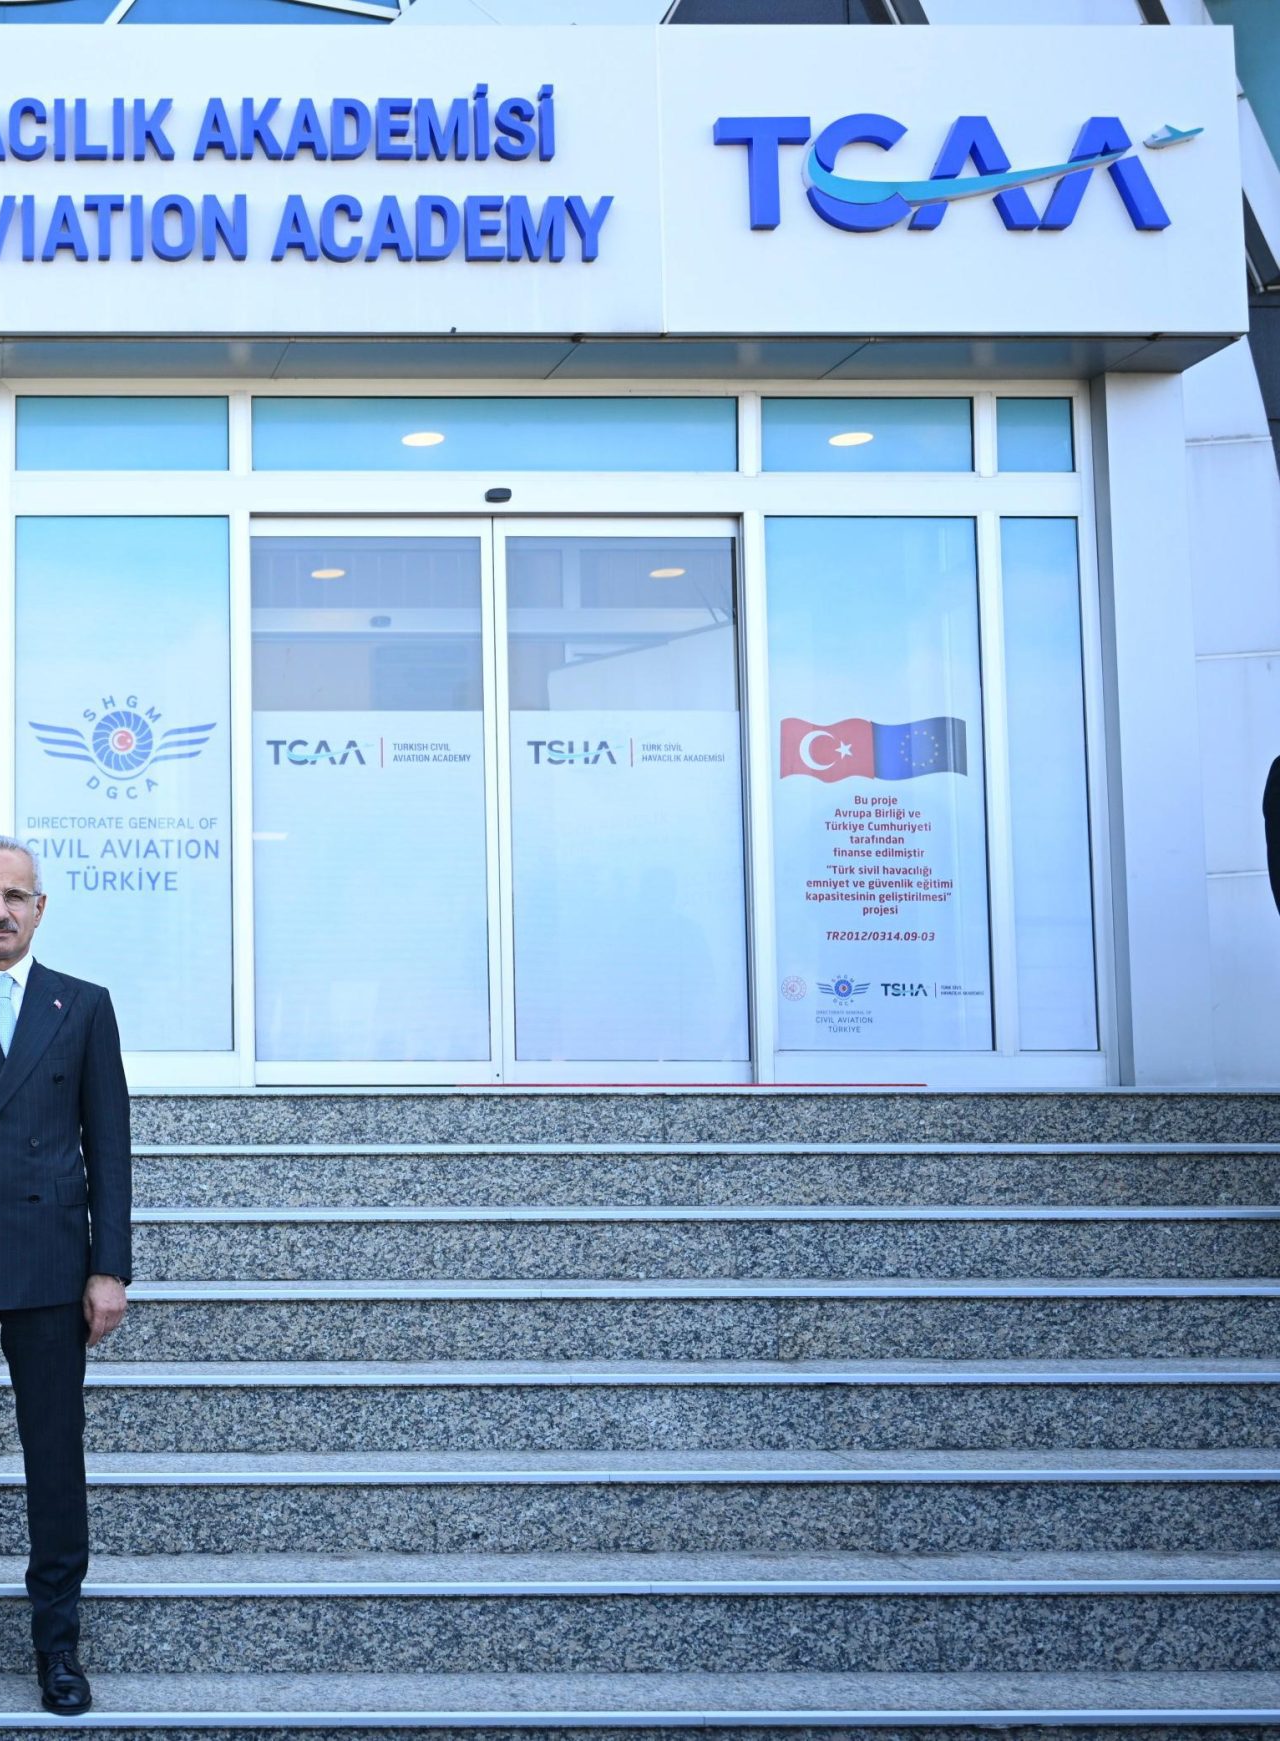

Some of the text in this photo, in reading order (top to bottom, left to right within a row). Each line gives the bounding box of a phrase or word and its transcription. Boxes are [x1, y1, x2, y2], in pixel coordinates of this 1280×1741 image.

[193, 83, 556, 162] AKADEMİSİ
[713, 113, 1172, 234] TCAA
[270, 194, 615, 263] ACADEMY
[83, 695, 162, 723] SHGM
[266, 740, 366, 766] TCAA
[393, 743, 452, 752] TURKISH CIVIL
[527, 740, 617, 766] TSHA
[392, 754, 471, 763] AVIATION ACADEMY
[641, 754, 682, 763] HAVACILIK
[86, 775, 159, 800] DGCA
[854, 795, 898, 807] Bu proje
[834, 808, 921, 820] Avrupa Birliği ve
[27, 816, 218, 830] DIRECTORATE GENERAL OF
[824, 821, 932, 834] Türkiye Cumhuriyeti
[849, 834, 905, 845] tarafından
[100, 838, 220, 860] AVIATION
[832, 847, 925, 860] finanse edilmiştir
[858, 865, 880, 875] sivil
[66, 865, 178, 891] TÜRKİYE
[805, 878, 954, 891] emniyet ve güvenlik eğitimi
[805, 891, 876, 903] kapasitesinin
[862, 904, 899, 917] projesi
[826, 931, 936, 941] TR2012/0314.09-03
[880, 982, 928, 997] TSHA
[815, 1016, 873, 1024] CIVIL AVIATION
